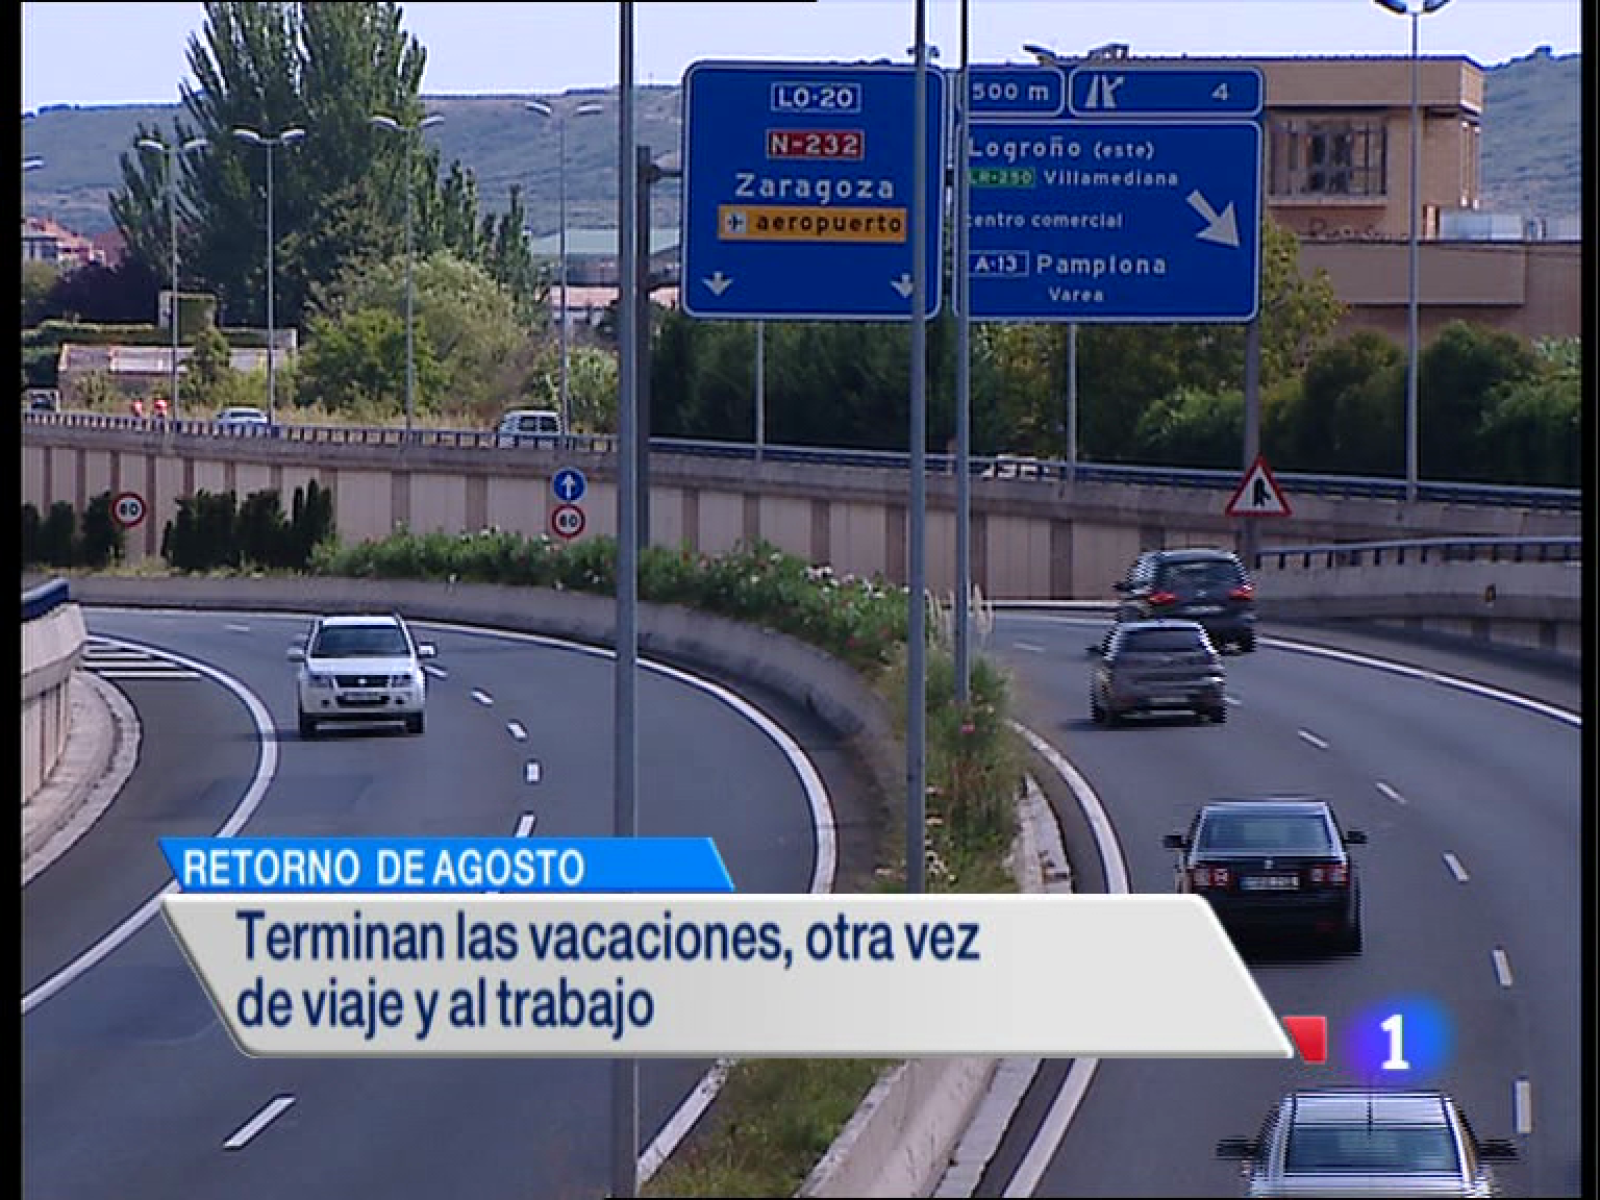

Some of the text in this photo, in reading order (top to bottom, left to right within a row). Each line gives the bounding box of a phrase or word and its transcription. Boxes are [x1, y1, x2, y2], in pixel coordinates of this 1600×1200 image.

[972, 83, 1049, 100] 500 m
[1212, 83, 1230, 100] 4
[770, 134, 858, 154] N-232
[968, 135, 1154, 162] Logroño (este)
[1044, 170, 1178, 186] Villamediana
[734, 173, 894, 204] Zaragoza
[756, 215, 902, 236] aeropuerto
[1031, 212, 1124, 228] comercial
[1037, 254, 1166, 277] Pamplona
[1049, 286, 1104, 302] Varea
